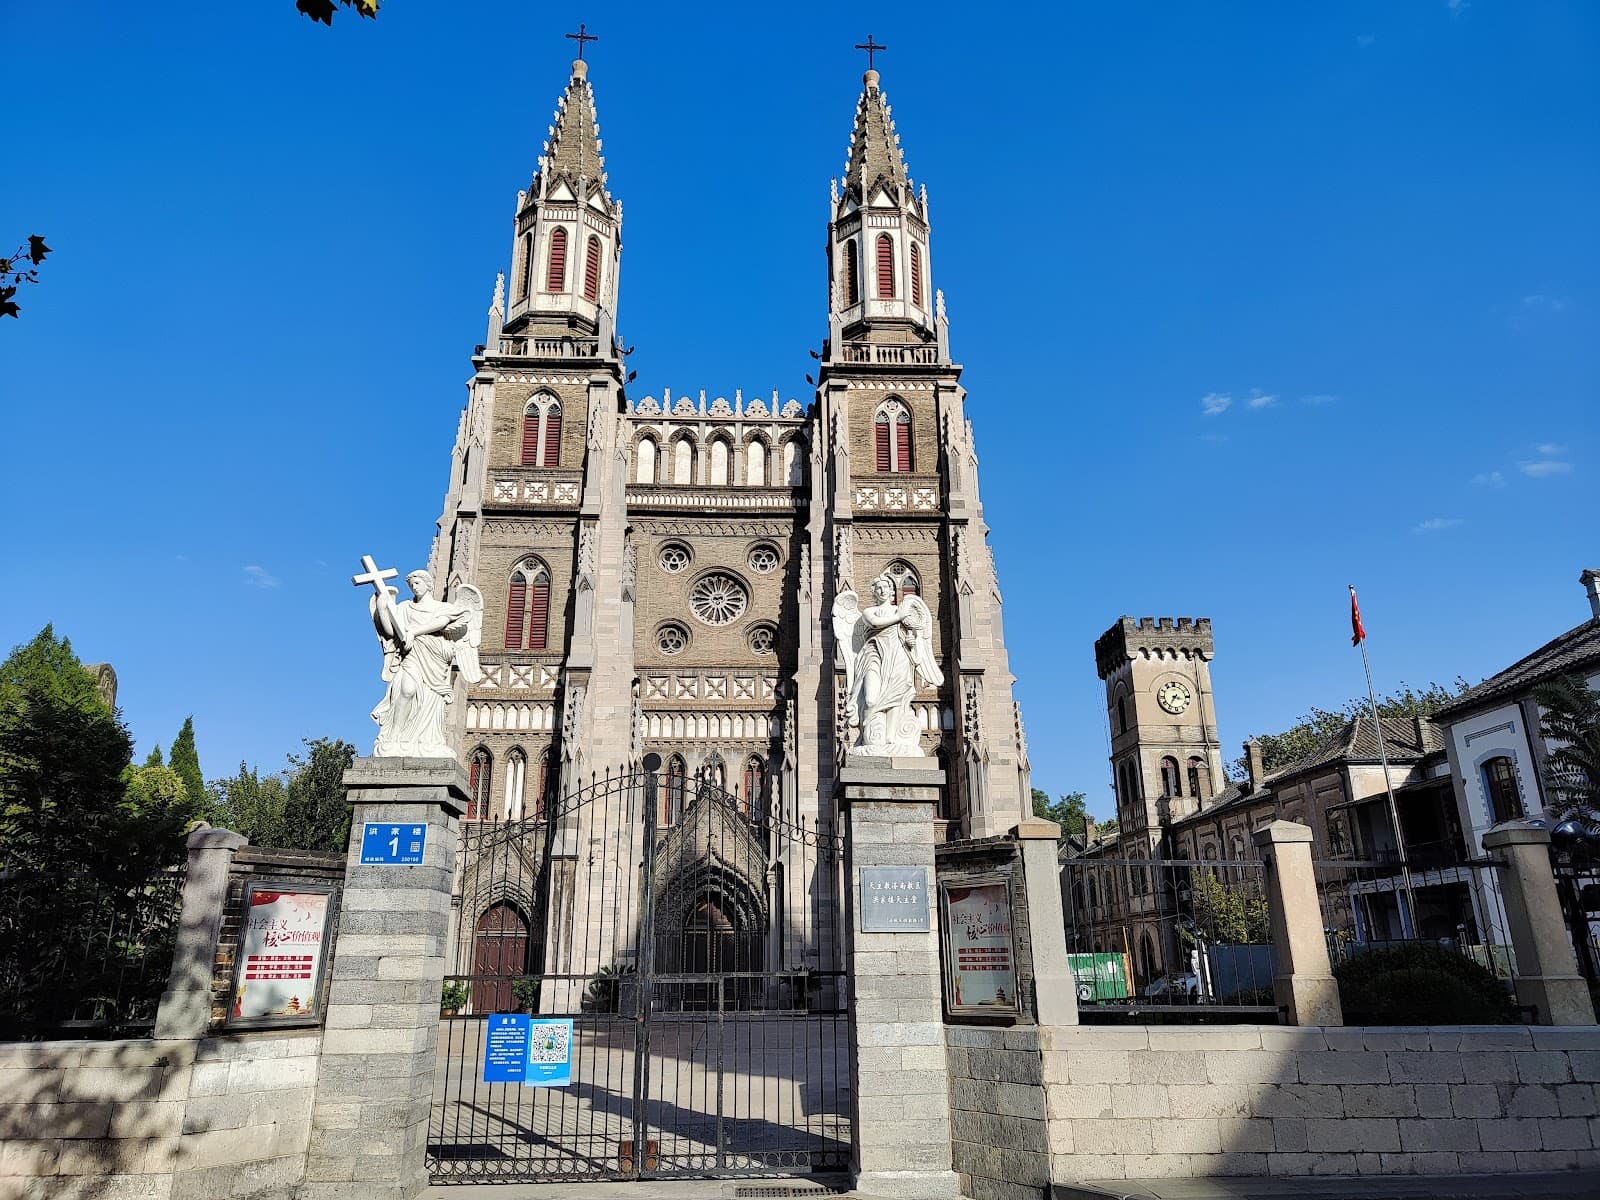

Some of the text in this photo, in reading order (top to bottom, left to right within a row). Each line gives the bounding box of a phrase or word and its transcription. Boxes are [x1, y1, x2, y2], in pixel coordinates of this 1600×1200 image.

[389, 837, 399, 857] 1
[249, 918, 288, 930] 社会主义
[953, 913, 983, 925] 社会主义
